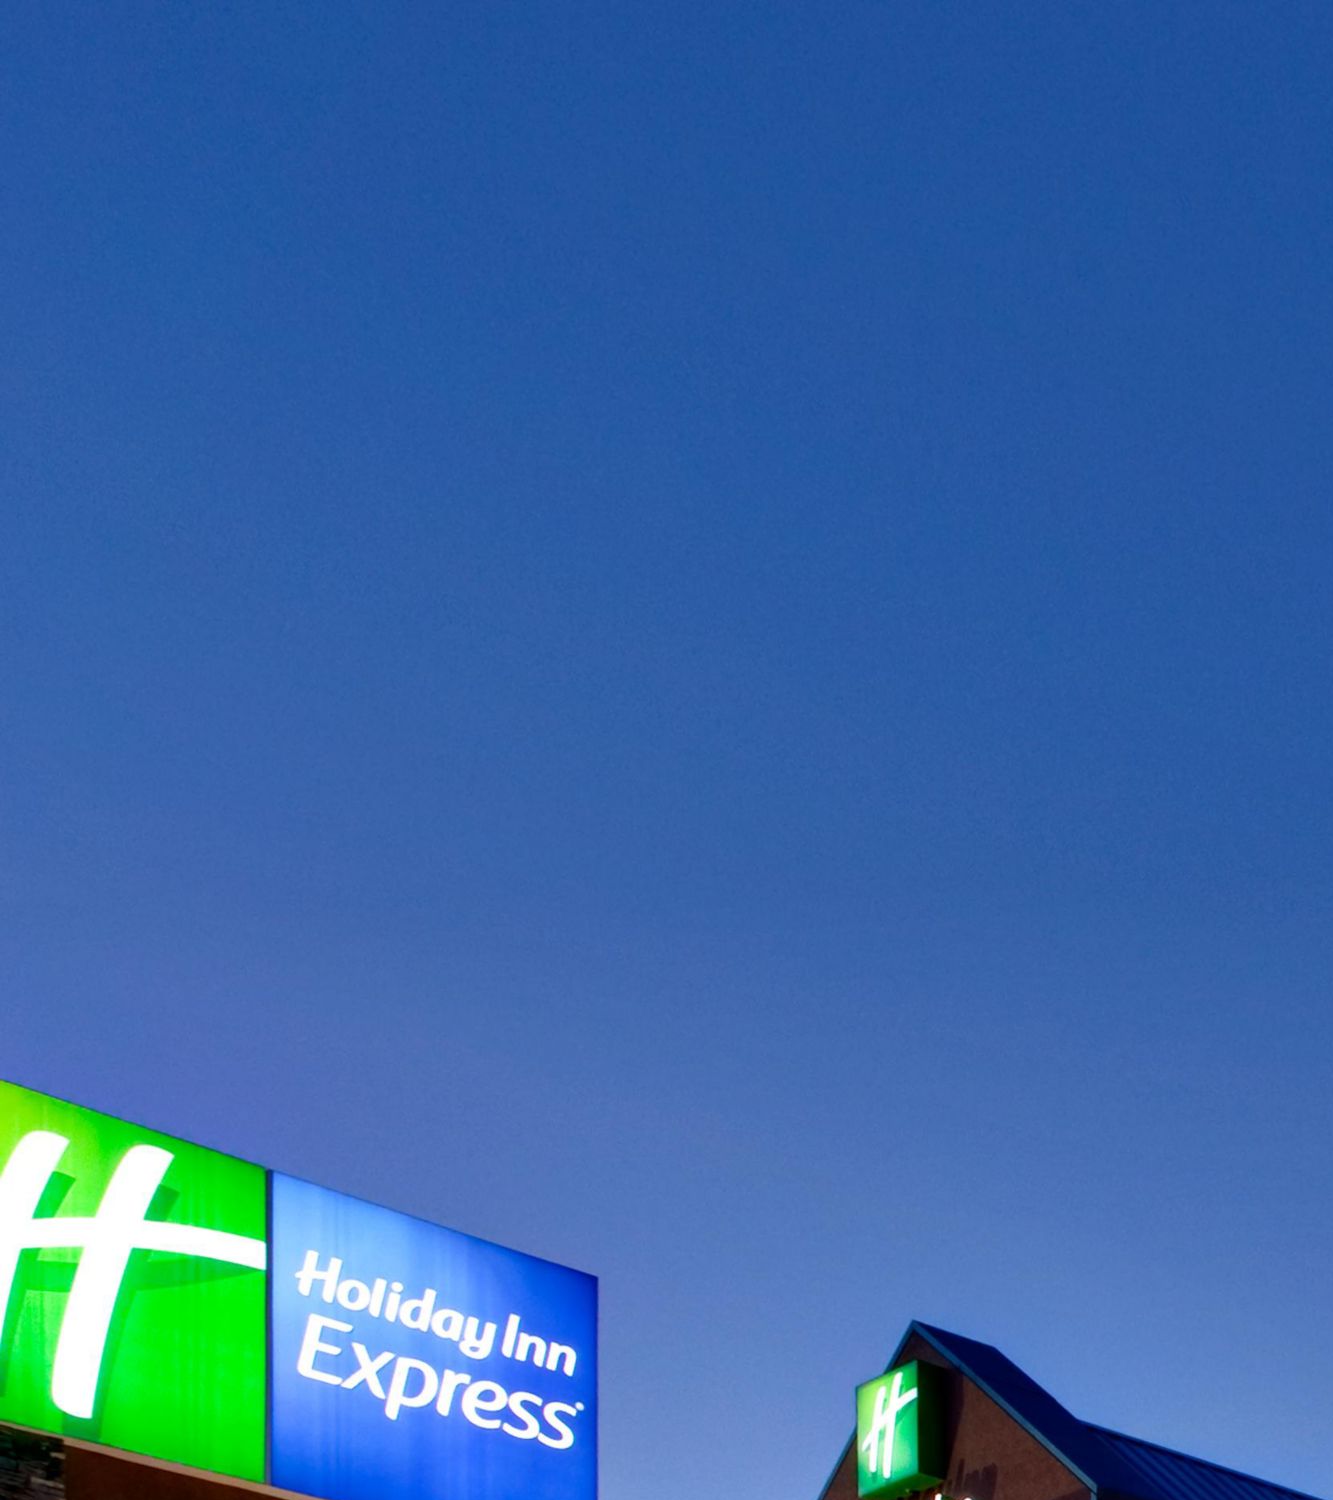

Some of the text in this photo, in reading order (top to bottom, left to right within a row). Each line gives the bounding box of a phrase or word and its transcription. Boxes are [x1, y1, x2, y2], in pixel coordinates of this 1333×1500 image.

[296, 1250, 577, 1377] Holiday Inn
[296, 1313, 584, 1450] Express
